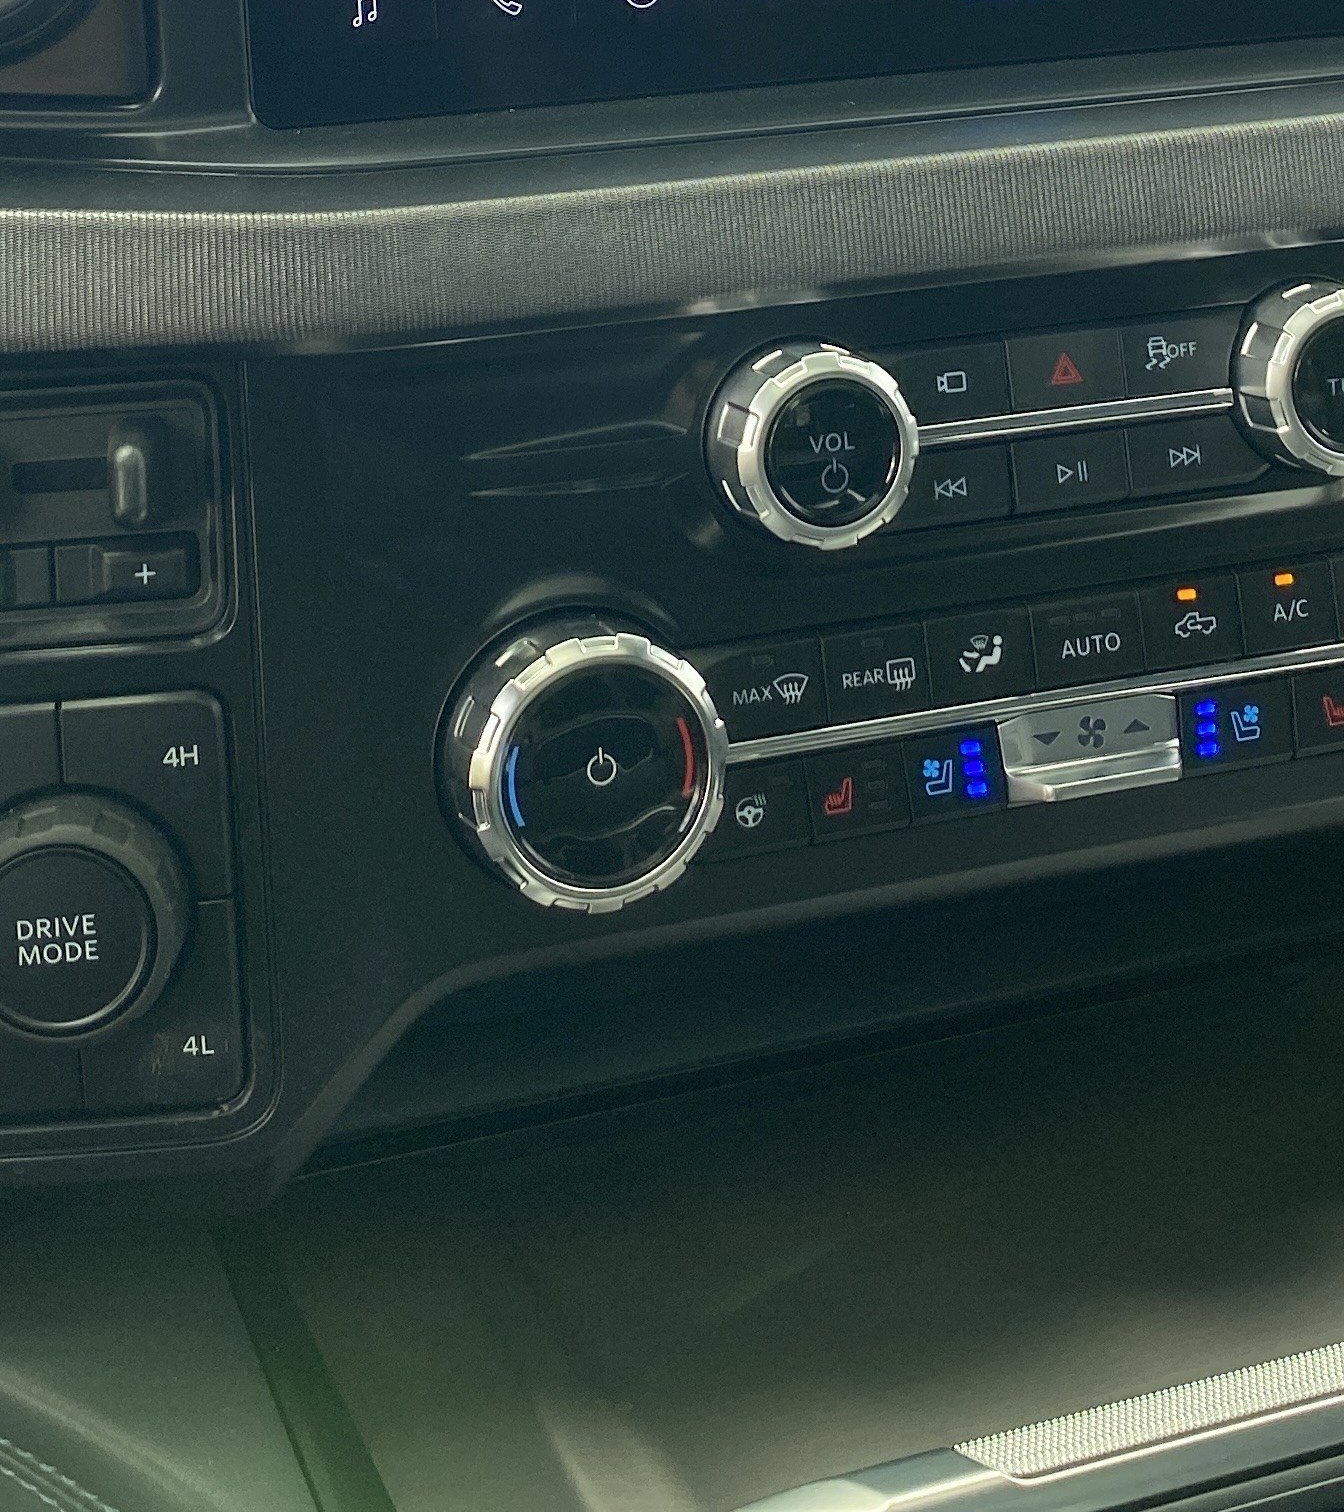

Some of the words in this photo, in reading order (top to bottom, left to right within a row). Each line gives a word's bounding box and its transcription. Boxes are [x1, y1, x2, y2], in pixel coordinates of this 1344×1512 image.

[1168, 341, 1198, 359] OFF
[809, 431, 855, 454] VOL
[1273, 599, 1309, 622] A/C
[1061, 632, 1120, 660] AUTO
[842, 668, 884, 689] REAR
[732, 686, 773, 706] MAX
[162, 745, 200, 768] 4H
[16, 913, 97, 941] DRIVE
[17, 939, 99, 967] MODE
[182, 1036, 215, 1057] 4L
